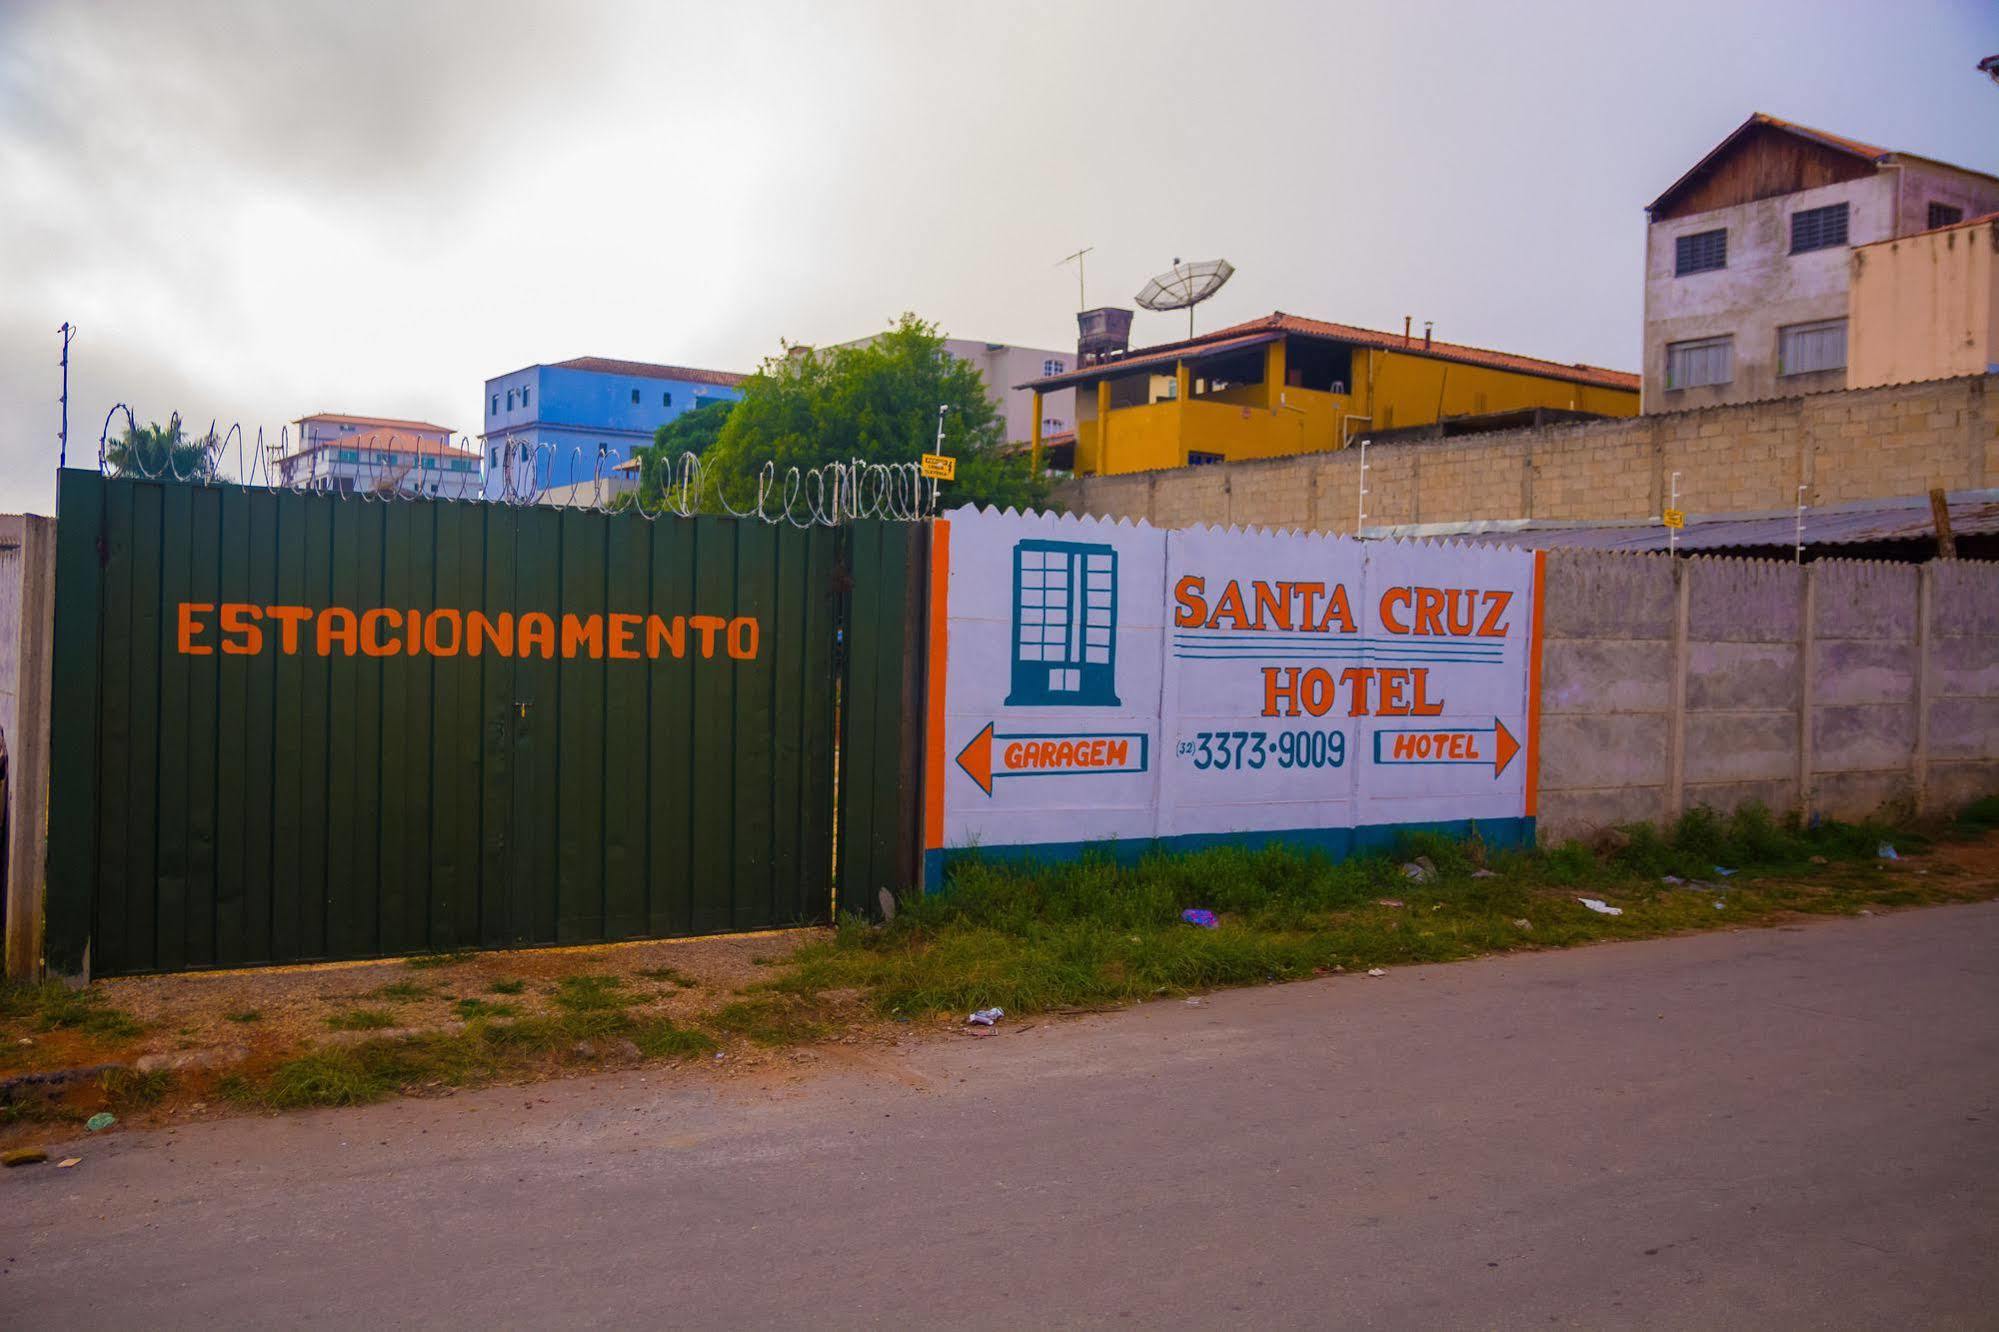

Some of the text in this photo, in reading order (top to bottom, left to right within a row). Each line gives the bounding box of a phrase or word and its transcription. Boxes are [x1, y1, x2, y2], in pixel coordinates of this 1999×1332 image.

[1174, 576, 1513, 638] SANTA CRUZ
[177, 602, 760, 660] ESTACIONAMENTO
[1261, 667, 1445, 718] HOTEL
[1003, 739, 1129, 770] GARAGEM
[1176, 740, 1196, 757] (32)
[1393, 733, 1480, 760] HOTEL
